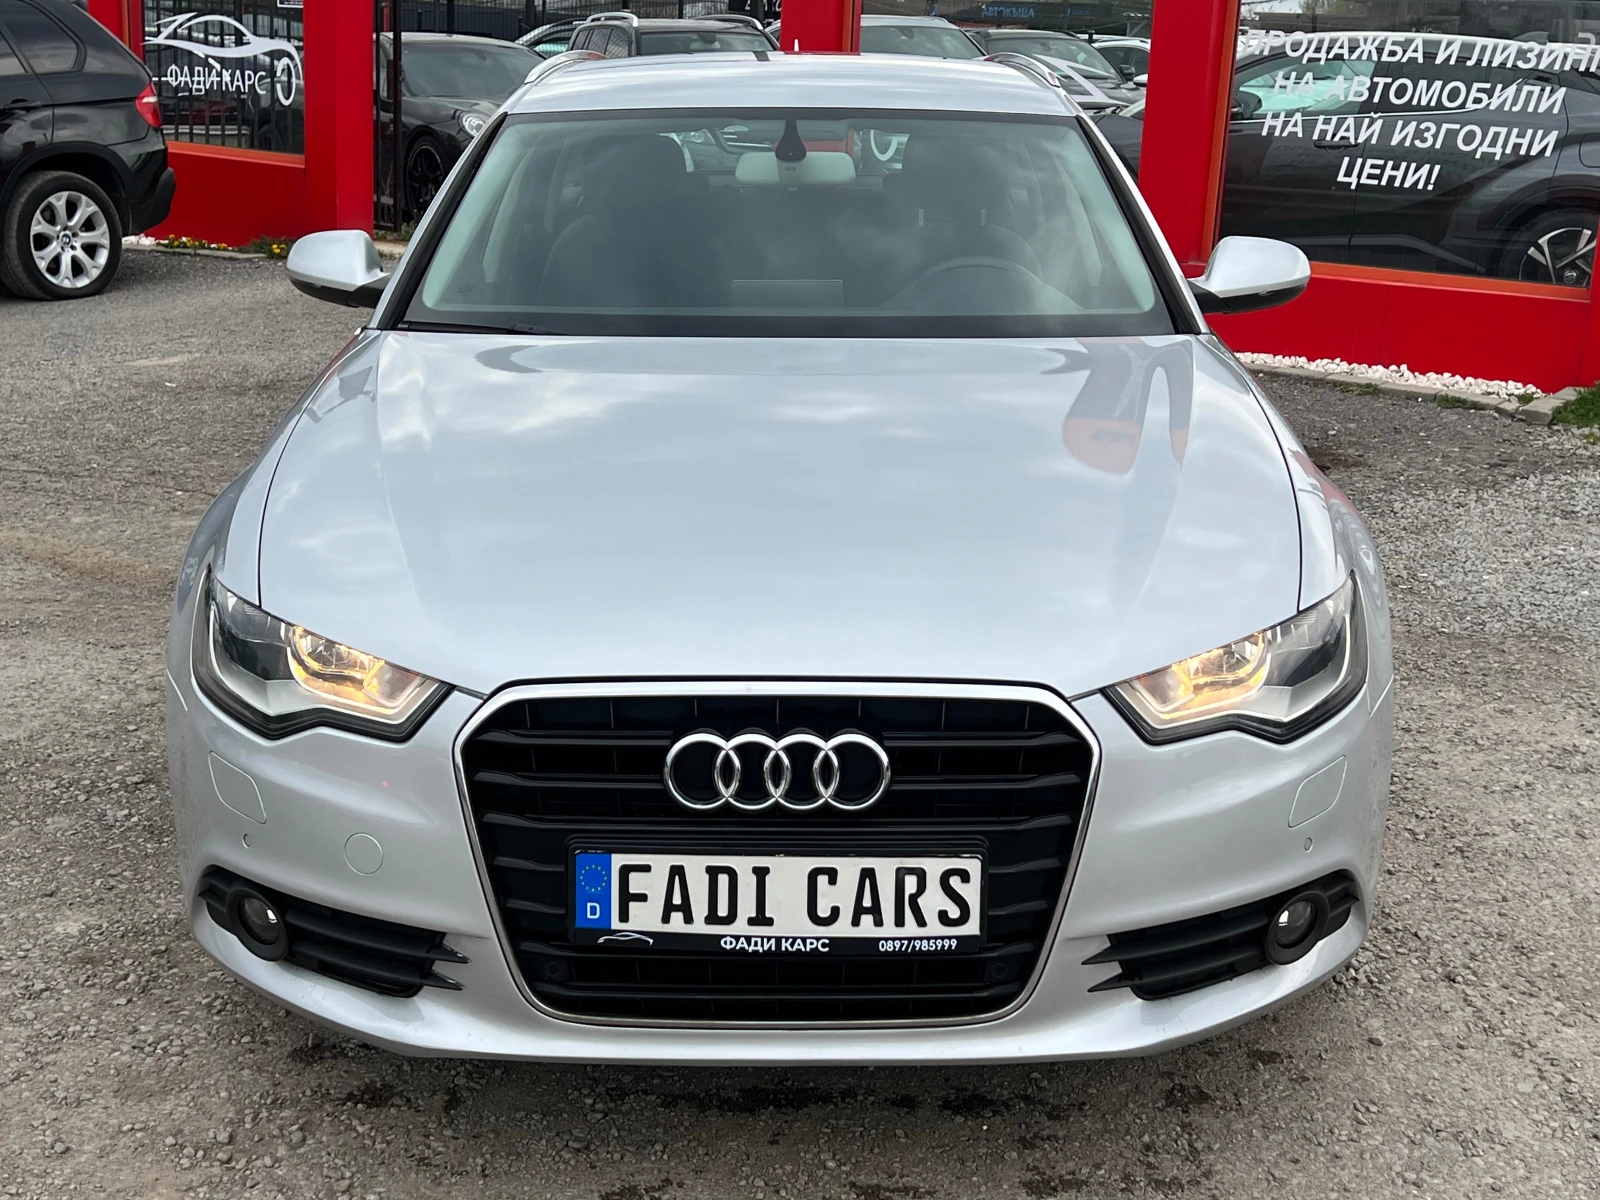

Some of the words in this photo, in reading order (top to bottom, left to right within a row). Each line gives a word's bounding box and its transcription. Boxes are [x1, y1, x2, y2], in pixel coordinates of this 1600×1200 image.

[1244, 29, 1425, 65] ПРОДАЖБА
[1435, 37, 1466, 66] И
[167, 63, 217, 95] ФАДИ
[222, 68, 267, 95] КАРС
[1273, 71, 1315, 97] НА
[1325, 74, 1567, 115] АВТОМОБИЛИ
[1261, 111, 1304, 138] НА
[1313, 112, 1382, 145] НАЙ
[1390, 120, 1559, 160] ИЗГОДНИ
[1336, 156, 1441, 191] ЦЕНИ!
[586, 902, 600, 920] D
[617, 863, 775, 927] FADI
[806, 866, 972, 929] CARS
[720, 935, 778, 952] ФАДИ
[781, 937, 830, 953] КАРС
[878, 937, 958, 954] 0897/985999
